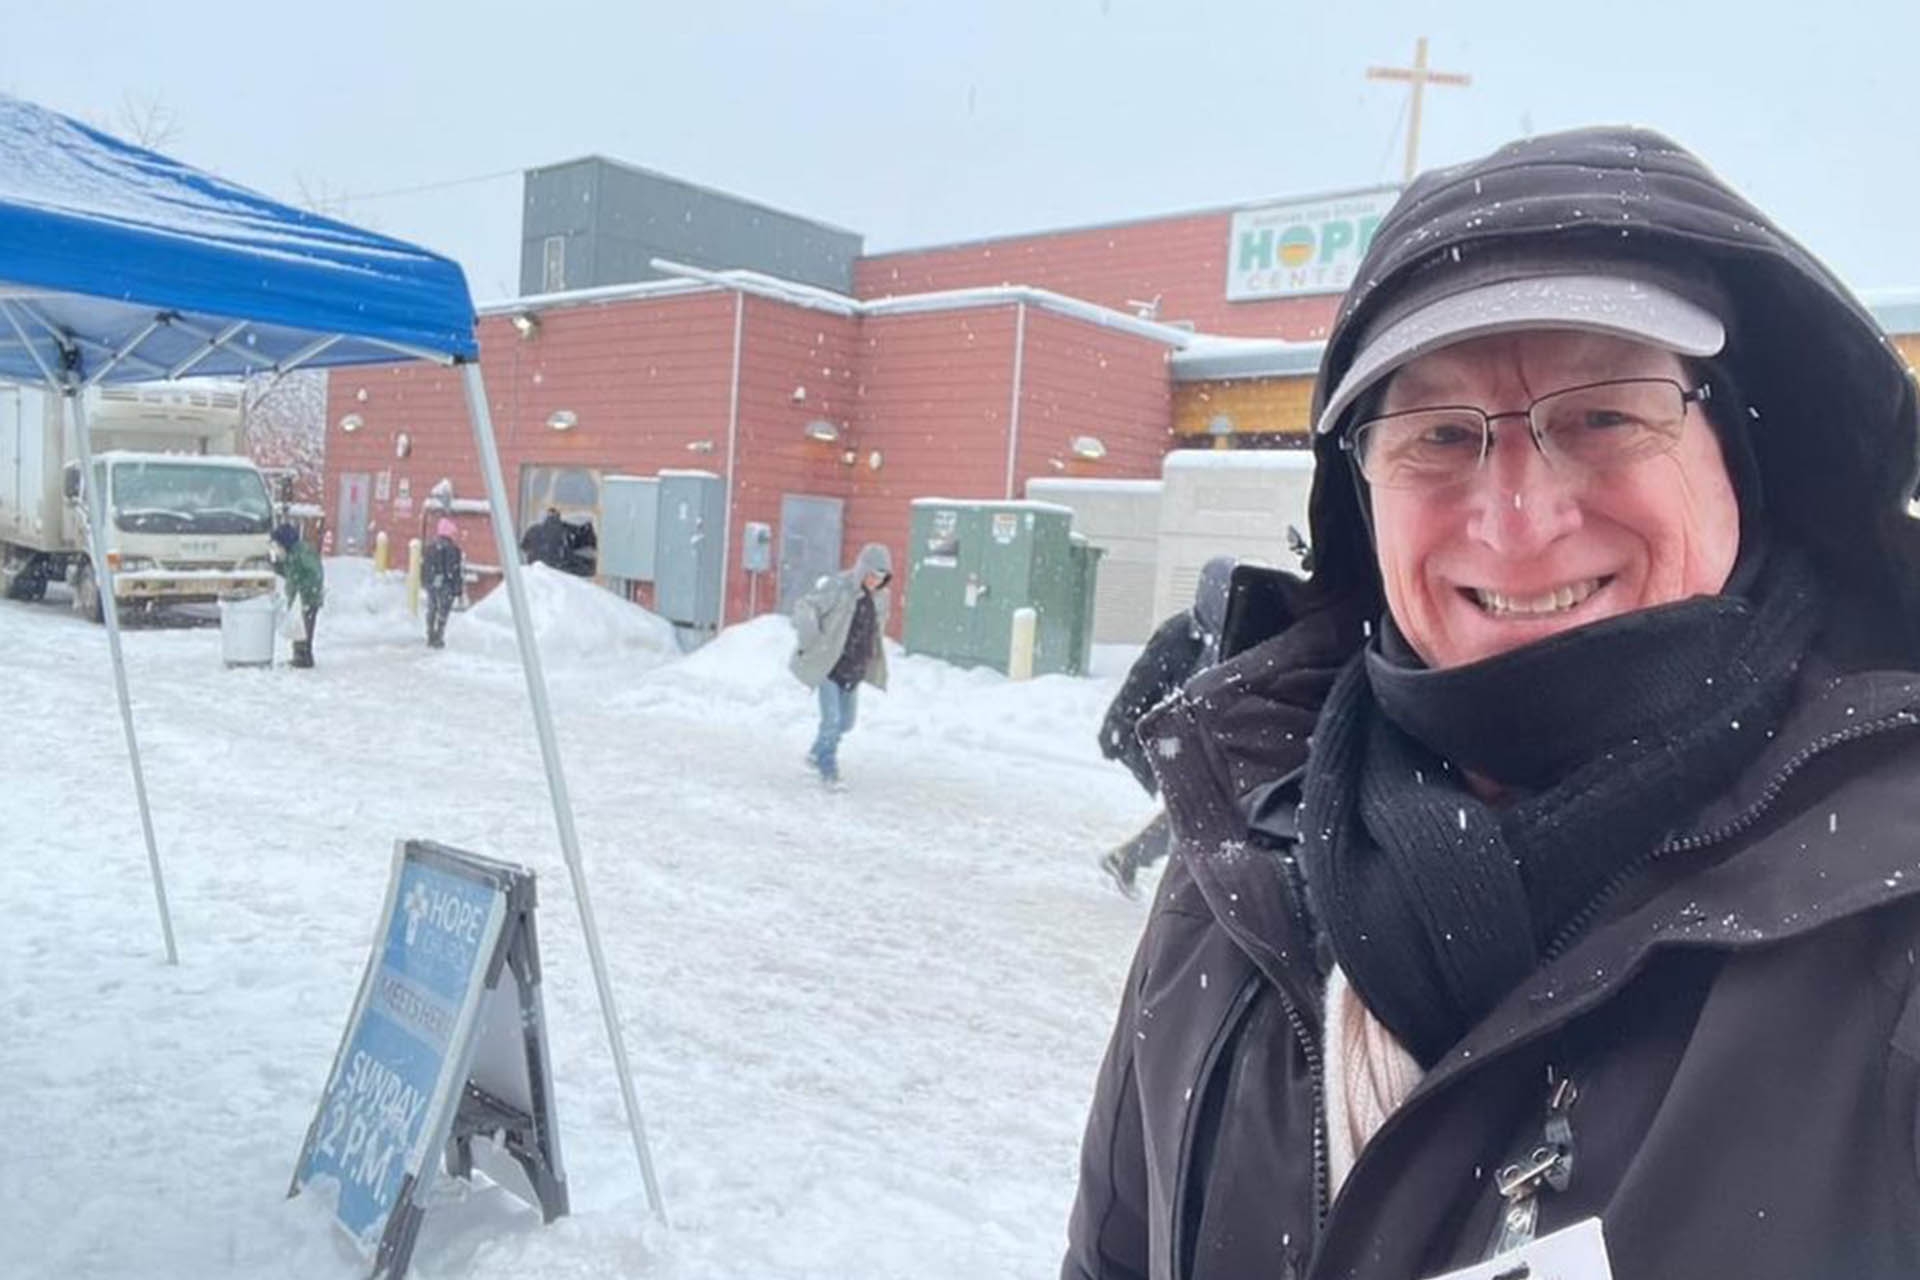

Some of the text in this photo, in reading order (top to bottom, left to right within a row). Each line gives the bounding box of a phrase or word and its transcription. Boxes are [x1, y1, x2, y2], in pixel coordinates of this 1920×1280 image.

[1248, 264, 1350, 290] CENTE
[429, 888, 483, 944] HOPE
[347, 1050, 427, 1146] SUNDAY
[339, 1115, 396, 1208] P.M.
